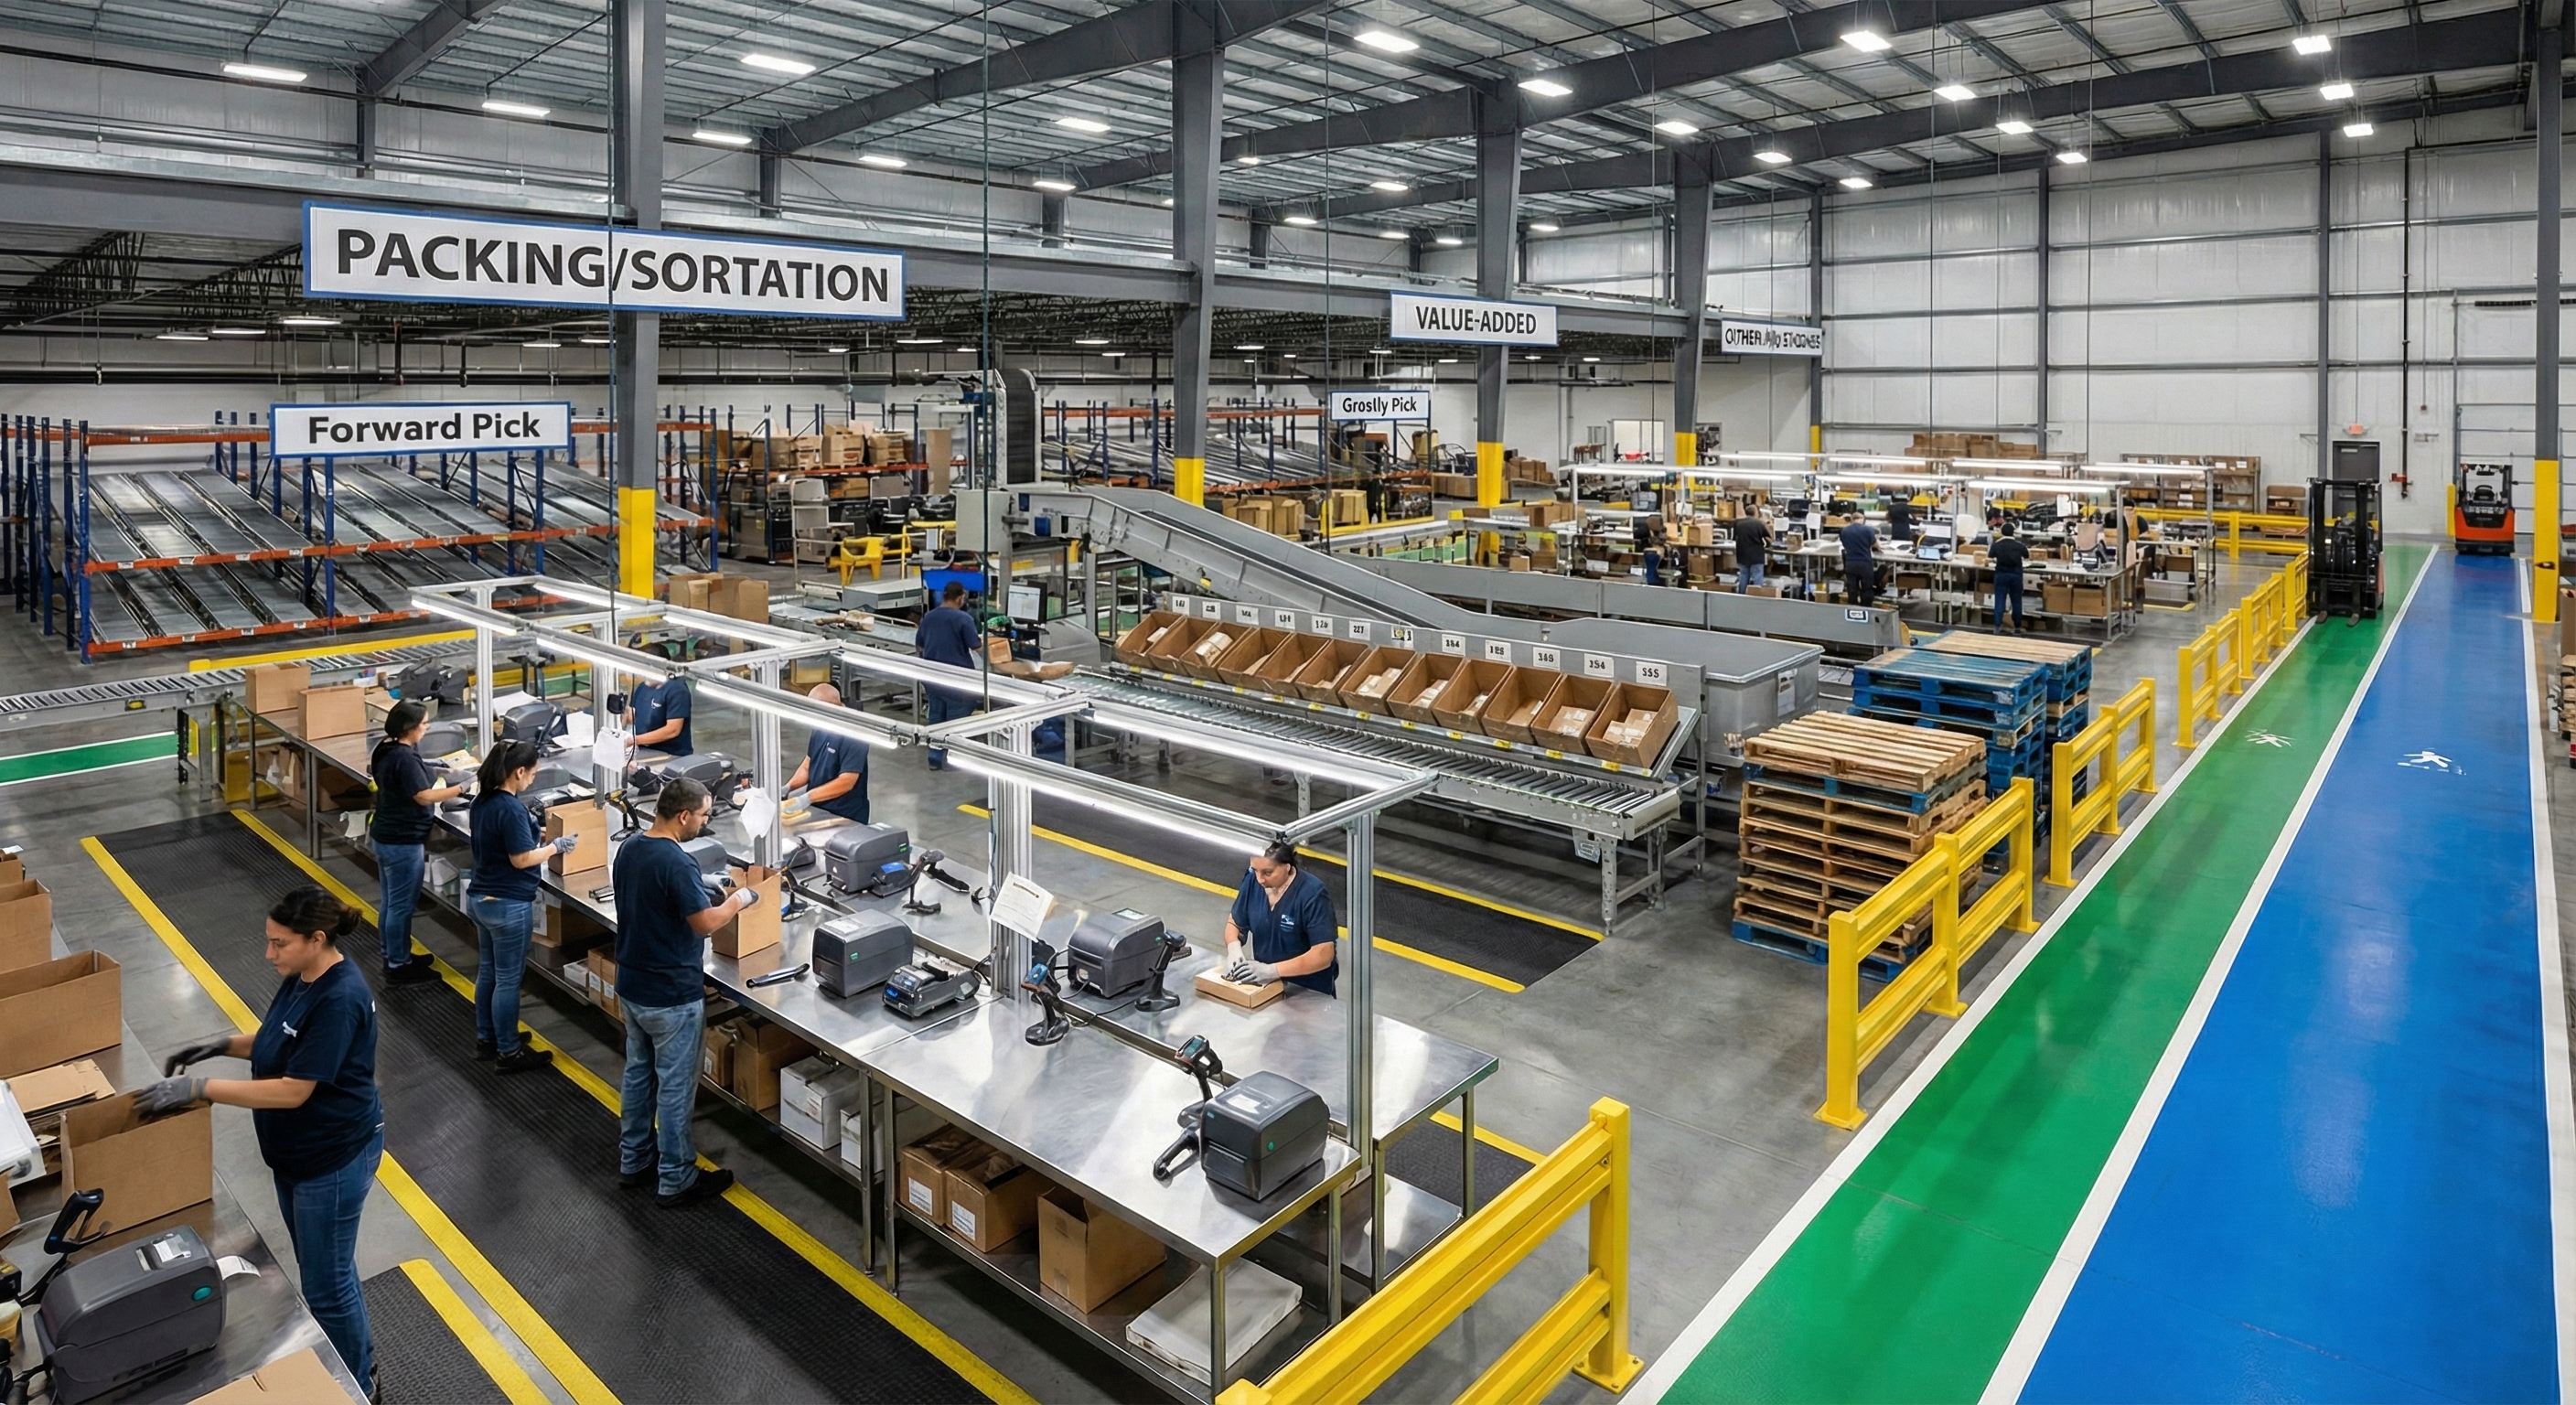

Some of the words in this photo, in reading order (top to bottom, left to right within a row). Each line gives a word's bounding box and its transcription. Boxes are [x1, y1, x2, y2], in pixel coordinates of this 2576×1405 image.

[337, 228, 889, 303] PACKING/SORTATION
[1415, 306, 1537, 335] VALUE-ADDED
[1392, 396, 1417, 413] Pick
[308, 413, 461, 444] Forward
[473, 412, 541, 439] Pick
